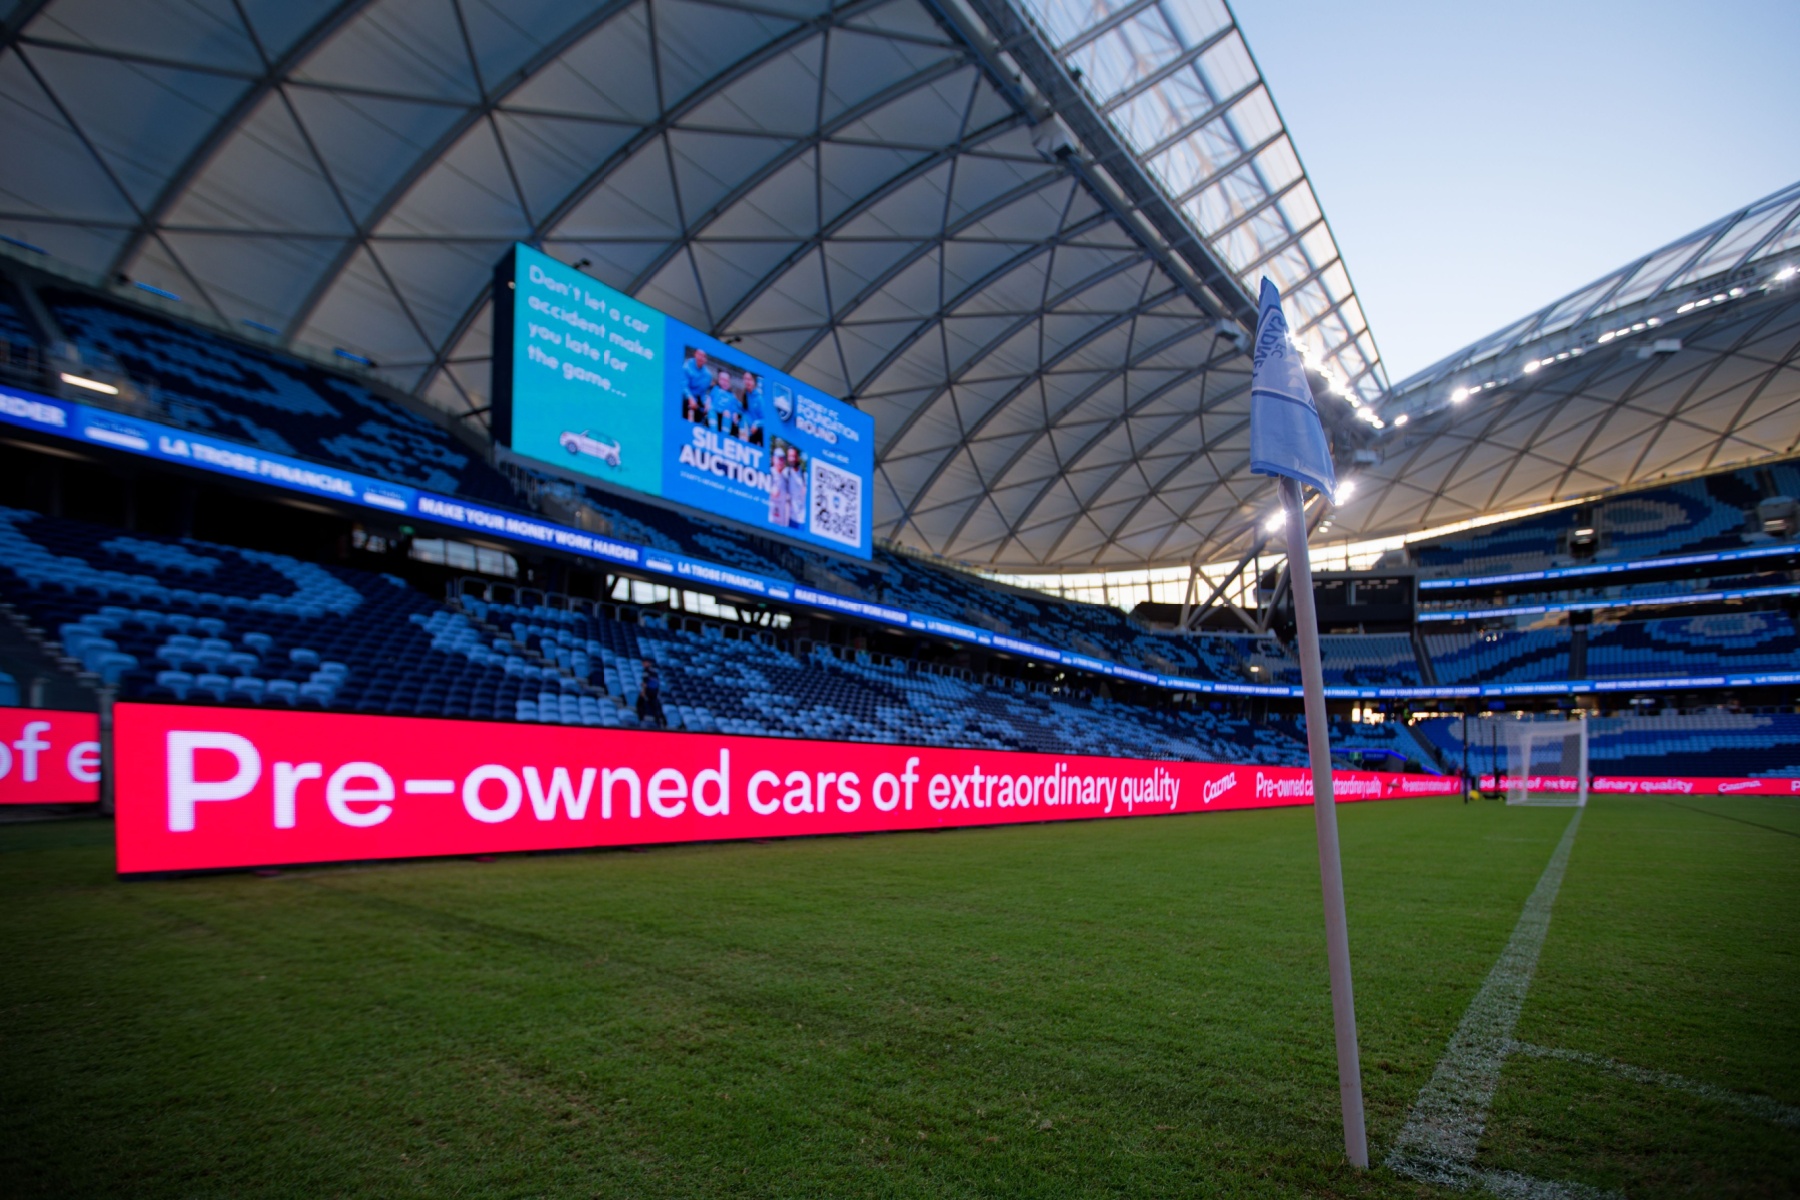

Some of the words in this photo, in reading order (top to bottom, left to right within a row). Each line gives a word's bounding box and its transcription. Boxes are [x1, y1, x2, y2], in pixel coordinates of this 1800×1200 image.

[529, 265, 581, 301] Don't
[585, 291, 606, 313] let
[609, 308, 620, 321] a
[624, 315, 650, 333] car
[528, 296, 605, 338] accident
[609, 332, 654, 360] make
[528, 322, 562, 345] you
[565, 333, 600, 361] late
[604, 350, 628, 371] for
[528, 345, 559, 370] the
[562, 362, 627, 397] game...
[159, 436, 191, 457] LA
[190, 442, 258, 474] TROBE
[260, 459, 356, 497] FINANCIAL
[679, 444, 772, 494] AUCTION
[692, 426, 763, 468] SILENT
[419, 497, 466, 522] MAKE
[465, 508, 506, 531] YOUR
[506, 518, 554, 542] MONEY
[555, 530, 593, 551] WORK
[593, 539, 638, 562] HARDER
[678, 562, 691, 574] LA
[691, 564, 721, 581] TROBE
[721, 571, 765, 592] FINANCIAL
[166, 730, 730, 832] Pre-owned
[747, 769, 861, 815] cars
[871, 756, 921, 812] of
[927, 762, 1118, 814] extraordinary
[1118, 767, 1181, 814] quality
[1203, 771, 1237, 804] Carma
[1256, 771, 1306, 798] Pre-owned
[1640, 777, 1693, 793] quality
